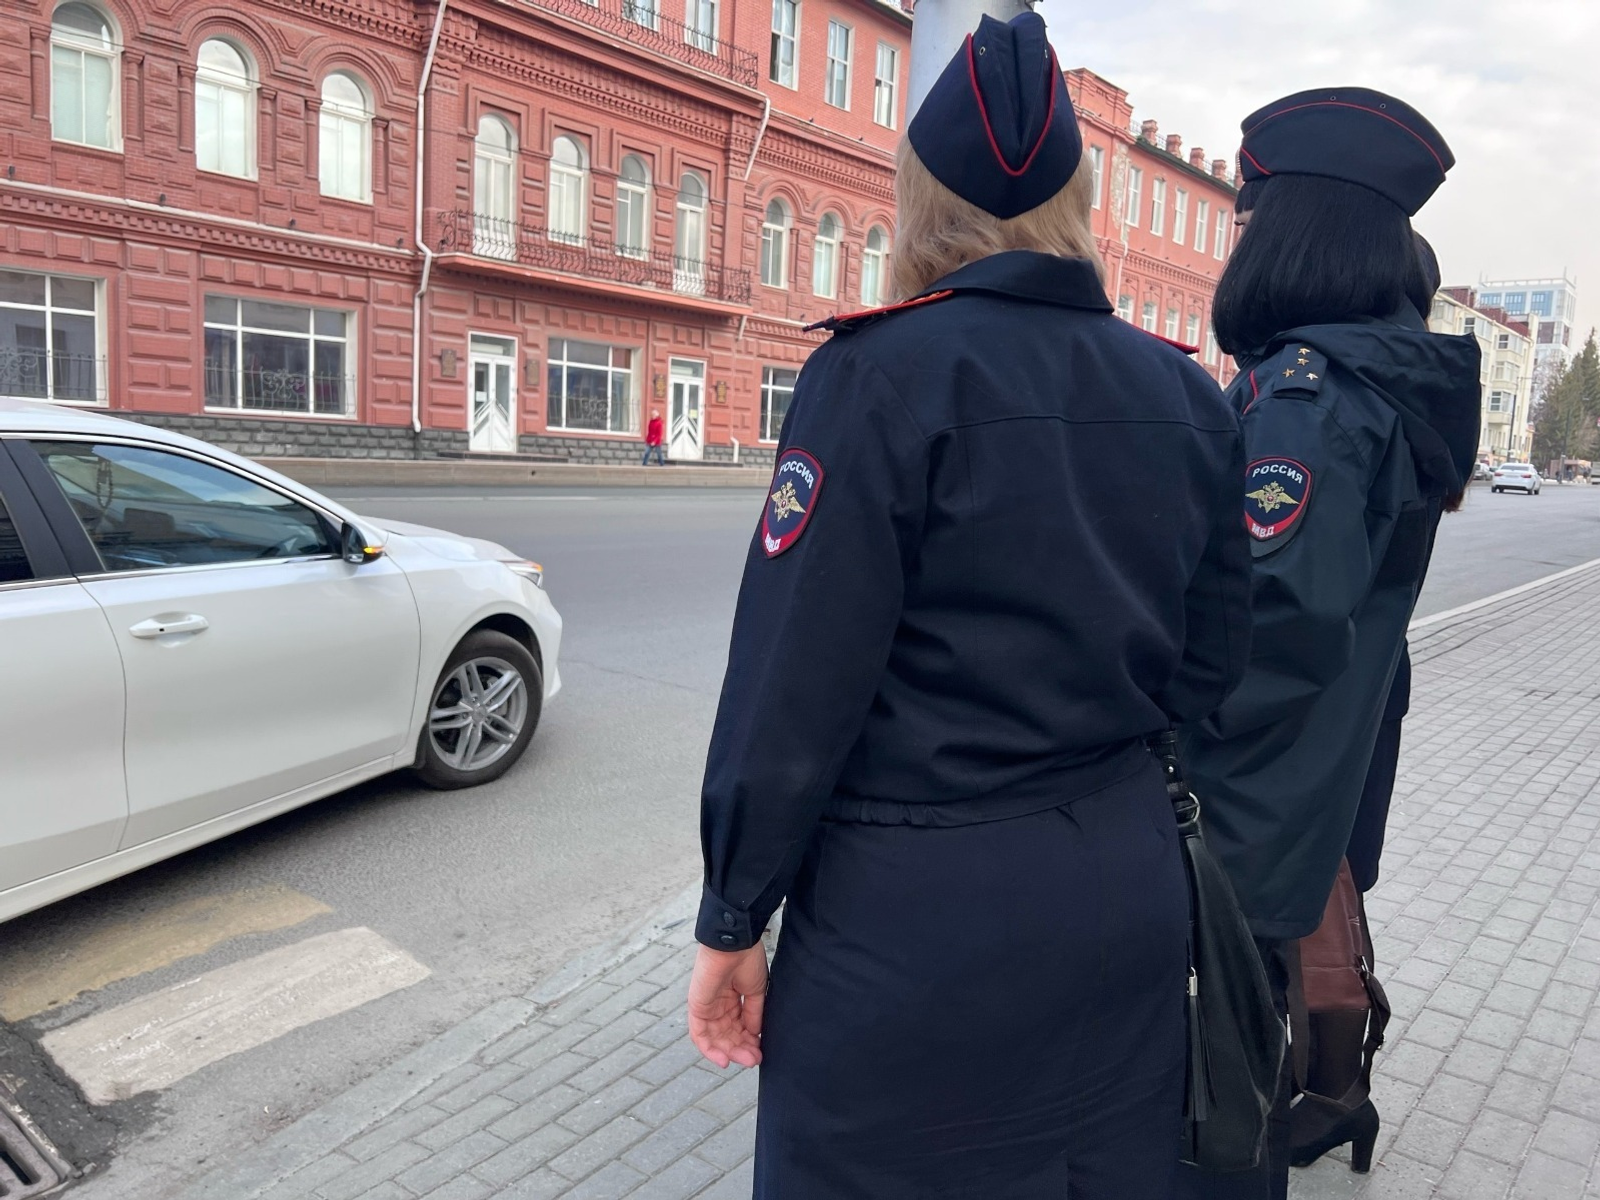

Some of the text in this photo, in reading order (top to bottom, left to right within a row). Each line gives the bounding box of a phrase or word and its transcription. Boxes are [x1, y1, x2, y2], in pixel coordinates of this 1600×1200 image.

[778, 461, 814, 489] РОССИЯ
[1252, 464, 1303, 484] РОССИЯ
[1251, 523, 1274, 538] МВД
